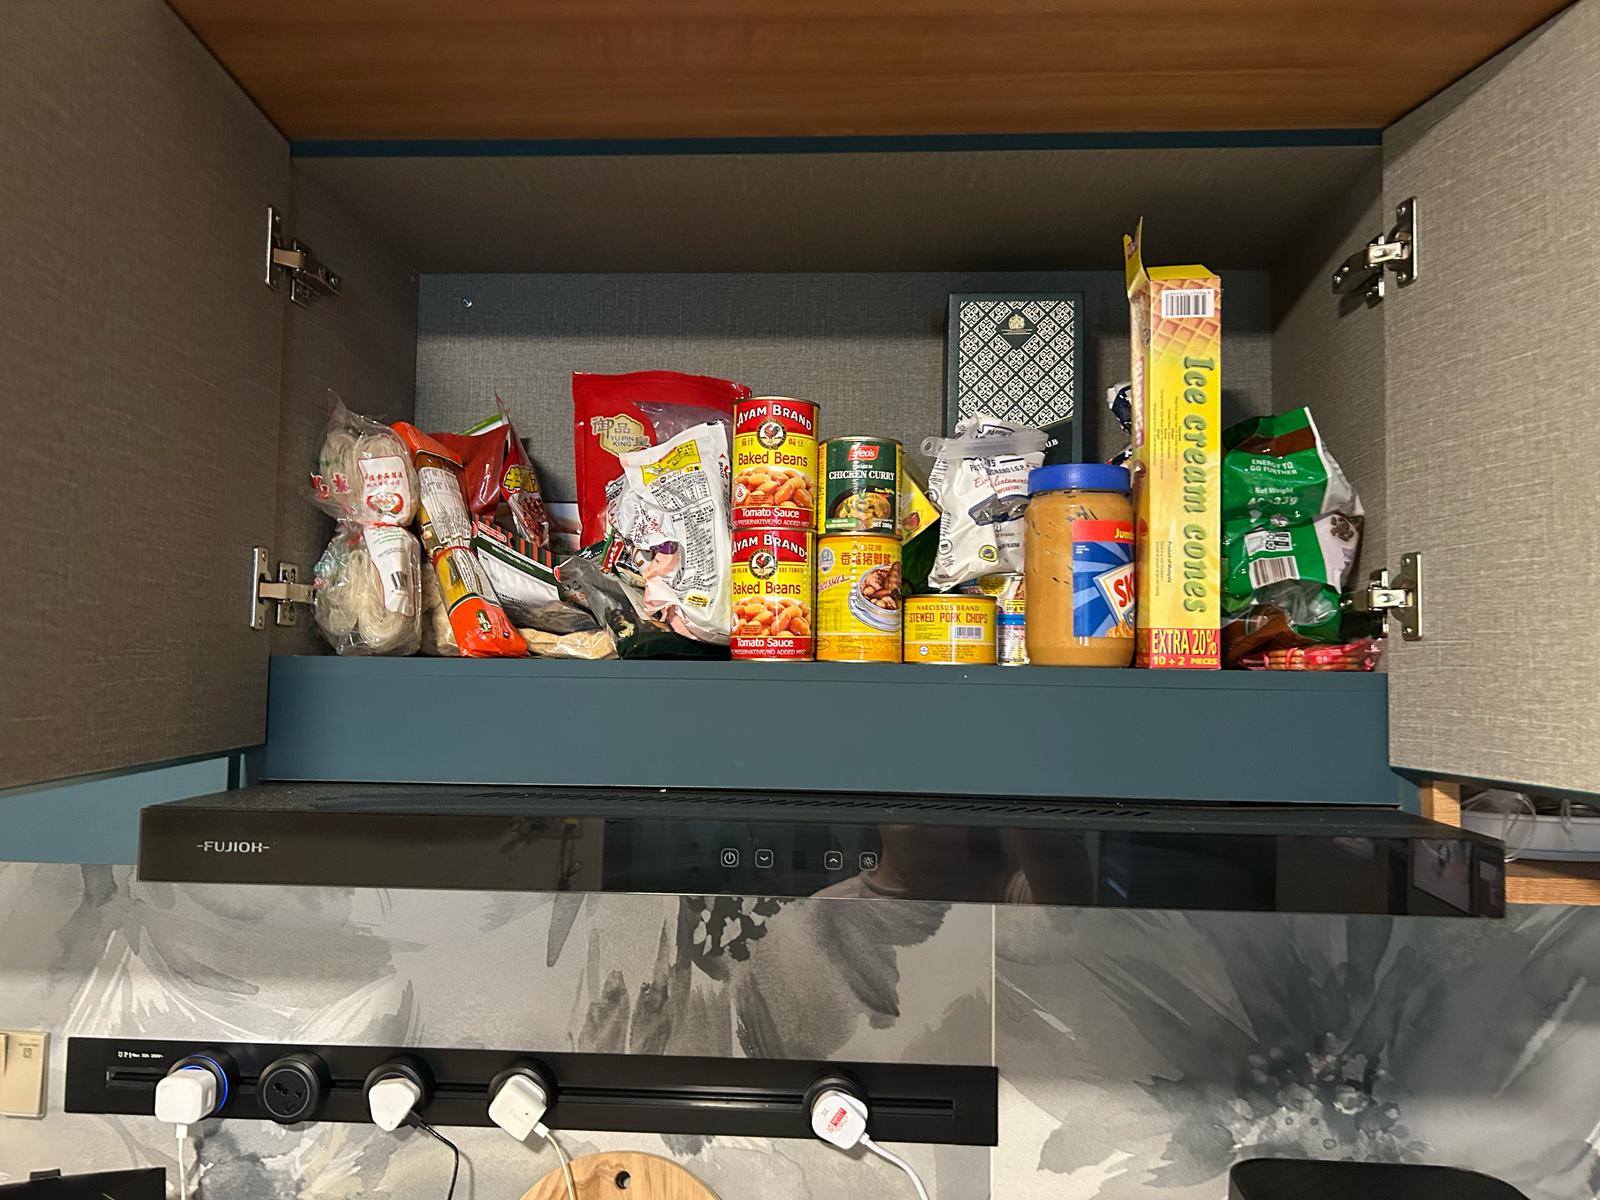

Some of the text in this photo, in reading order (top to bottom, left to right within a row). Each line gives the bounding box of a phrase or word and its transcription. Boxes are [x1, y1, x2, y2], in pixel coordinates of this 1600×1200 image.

[736, 404, 812, 430] AYAM BRAND
[1045, 438, 1059, 448] UB
[738, 451, 808, 467] Baked Beans
[1263, 466, 1298, 475] FURTHER
[1282, 461, 1294, 470] TO
[829, 469, 895, 481] CHICKEN CURRY
[1183, 356, 1214, 612] Ice cream cones
[742, 508, 800, 518] Tomato Sauce
[732, 534, 805, 557] AYAM BRAND
[733, 582, 801, 595] Baked Beans
[1113, 573, 1135, 608] SK
[909, 613, 988, 624] STEWED PORK CHOPS
[737, 638, 794, 647] Tomato Sauce
[1151, 629, 1218, 655] EXTRA 20%
[1152, 656, 1167, 665] 10
[1177, 656, 1186, 665] 2
[1190, 657, 1218, 665] PIECES
